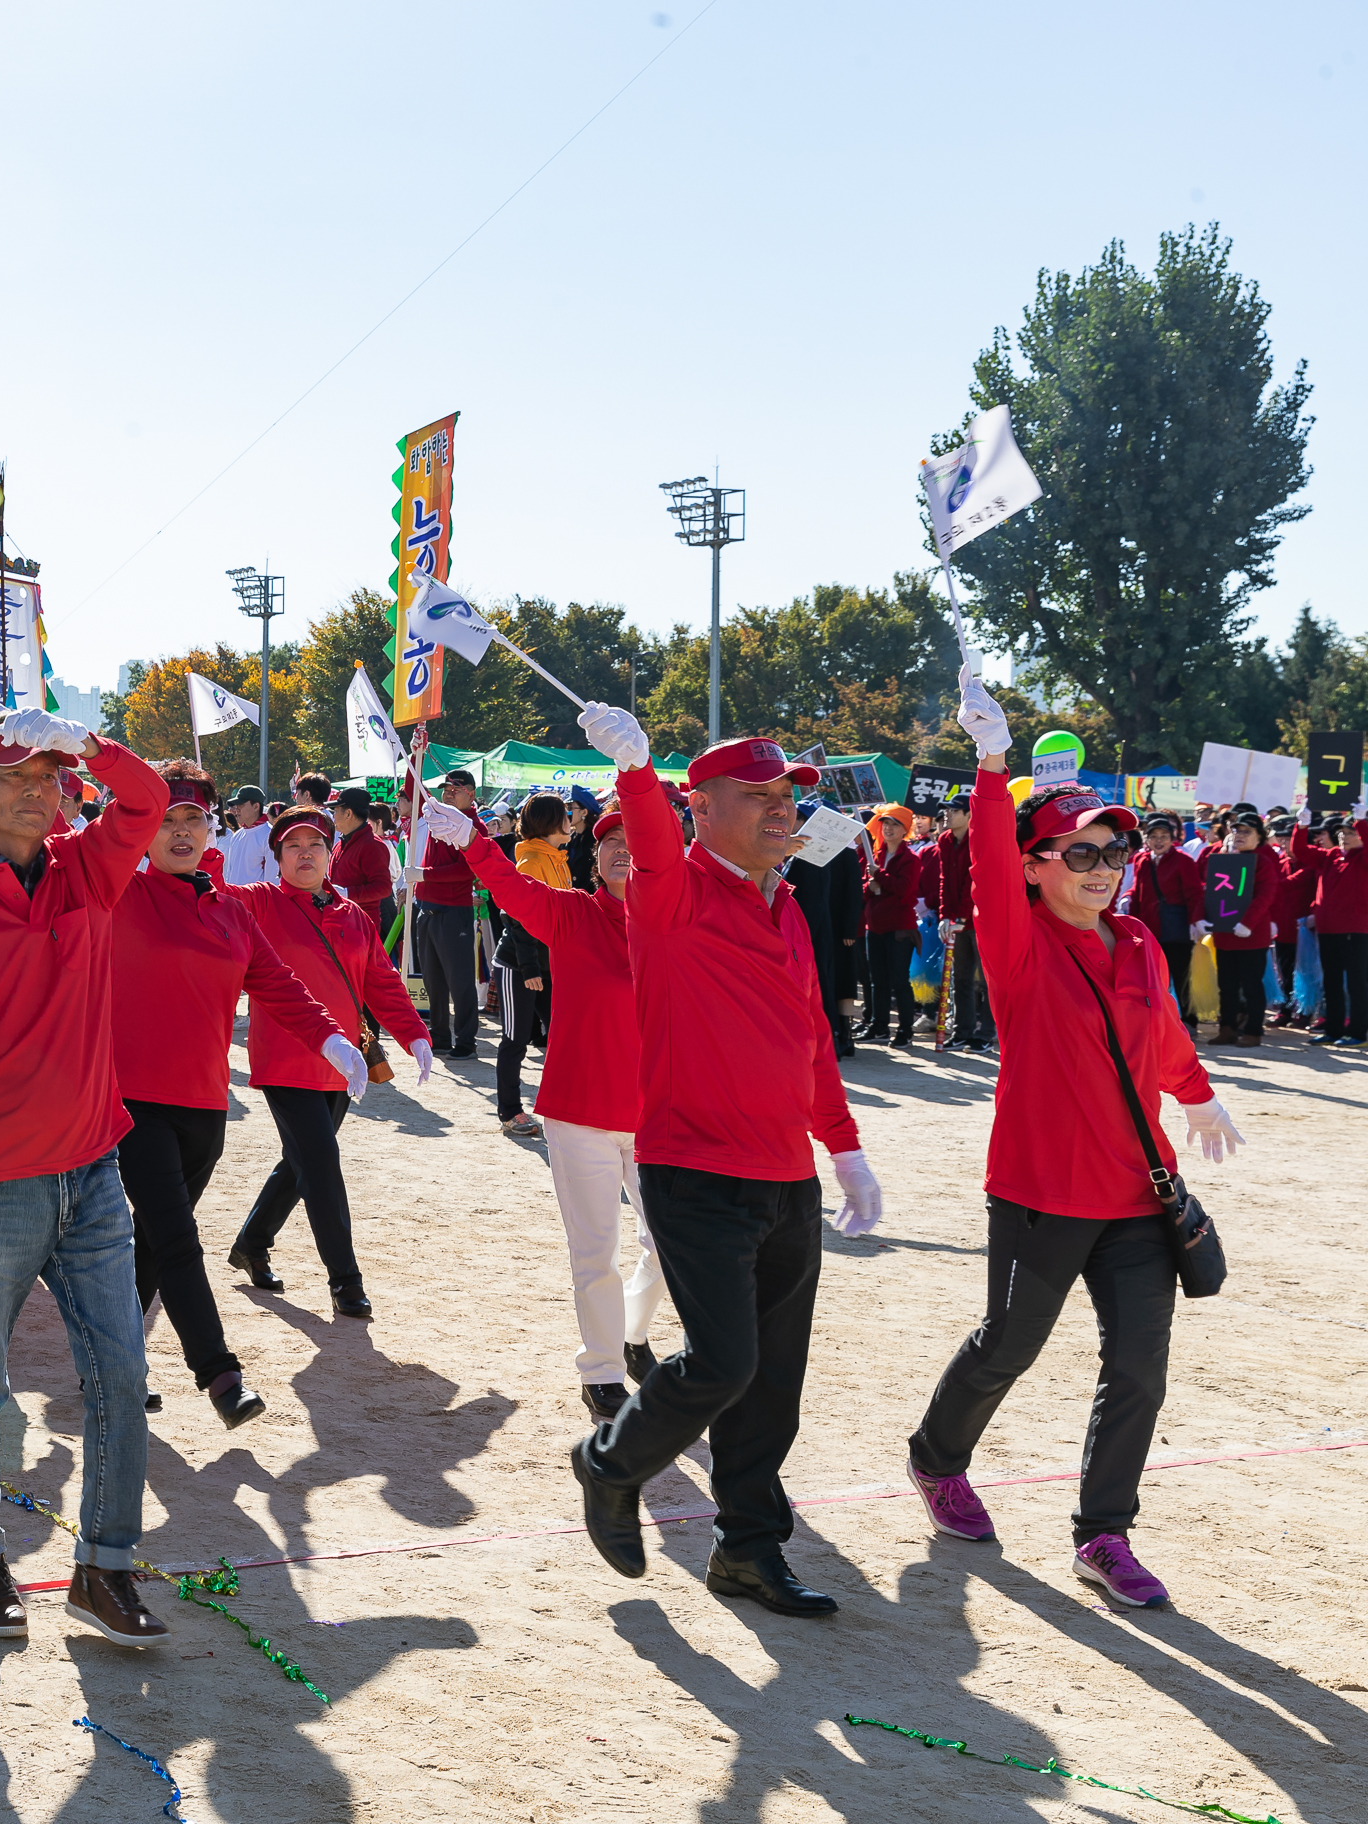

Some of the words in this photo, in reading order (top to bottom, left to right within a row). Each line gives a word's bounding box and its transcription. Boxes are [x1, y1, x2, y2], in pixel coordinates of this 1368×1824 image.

[409, 429, 448, 476] 화합하는
[1319, 754, 1350, 795] 구
[1214, 866, 1247, 918] 진
